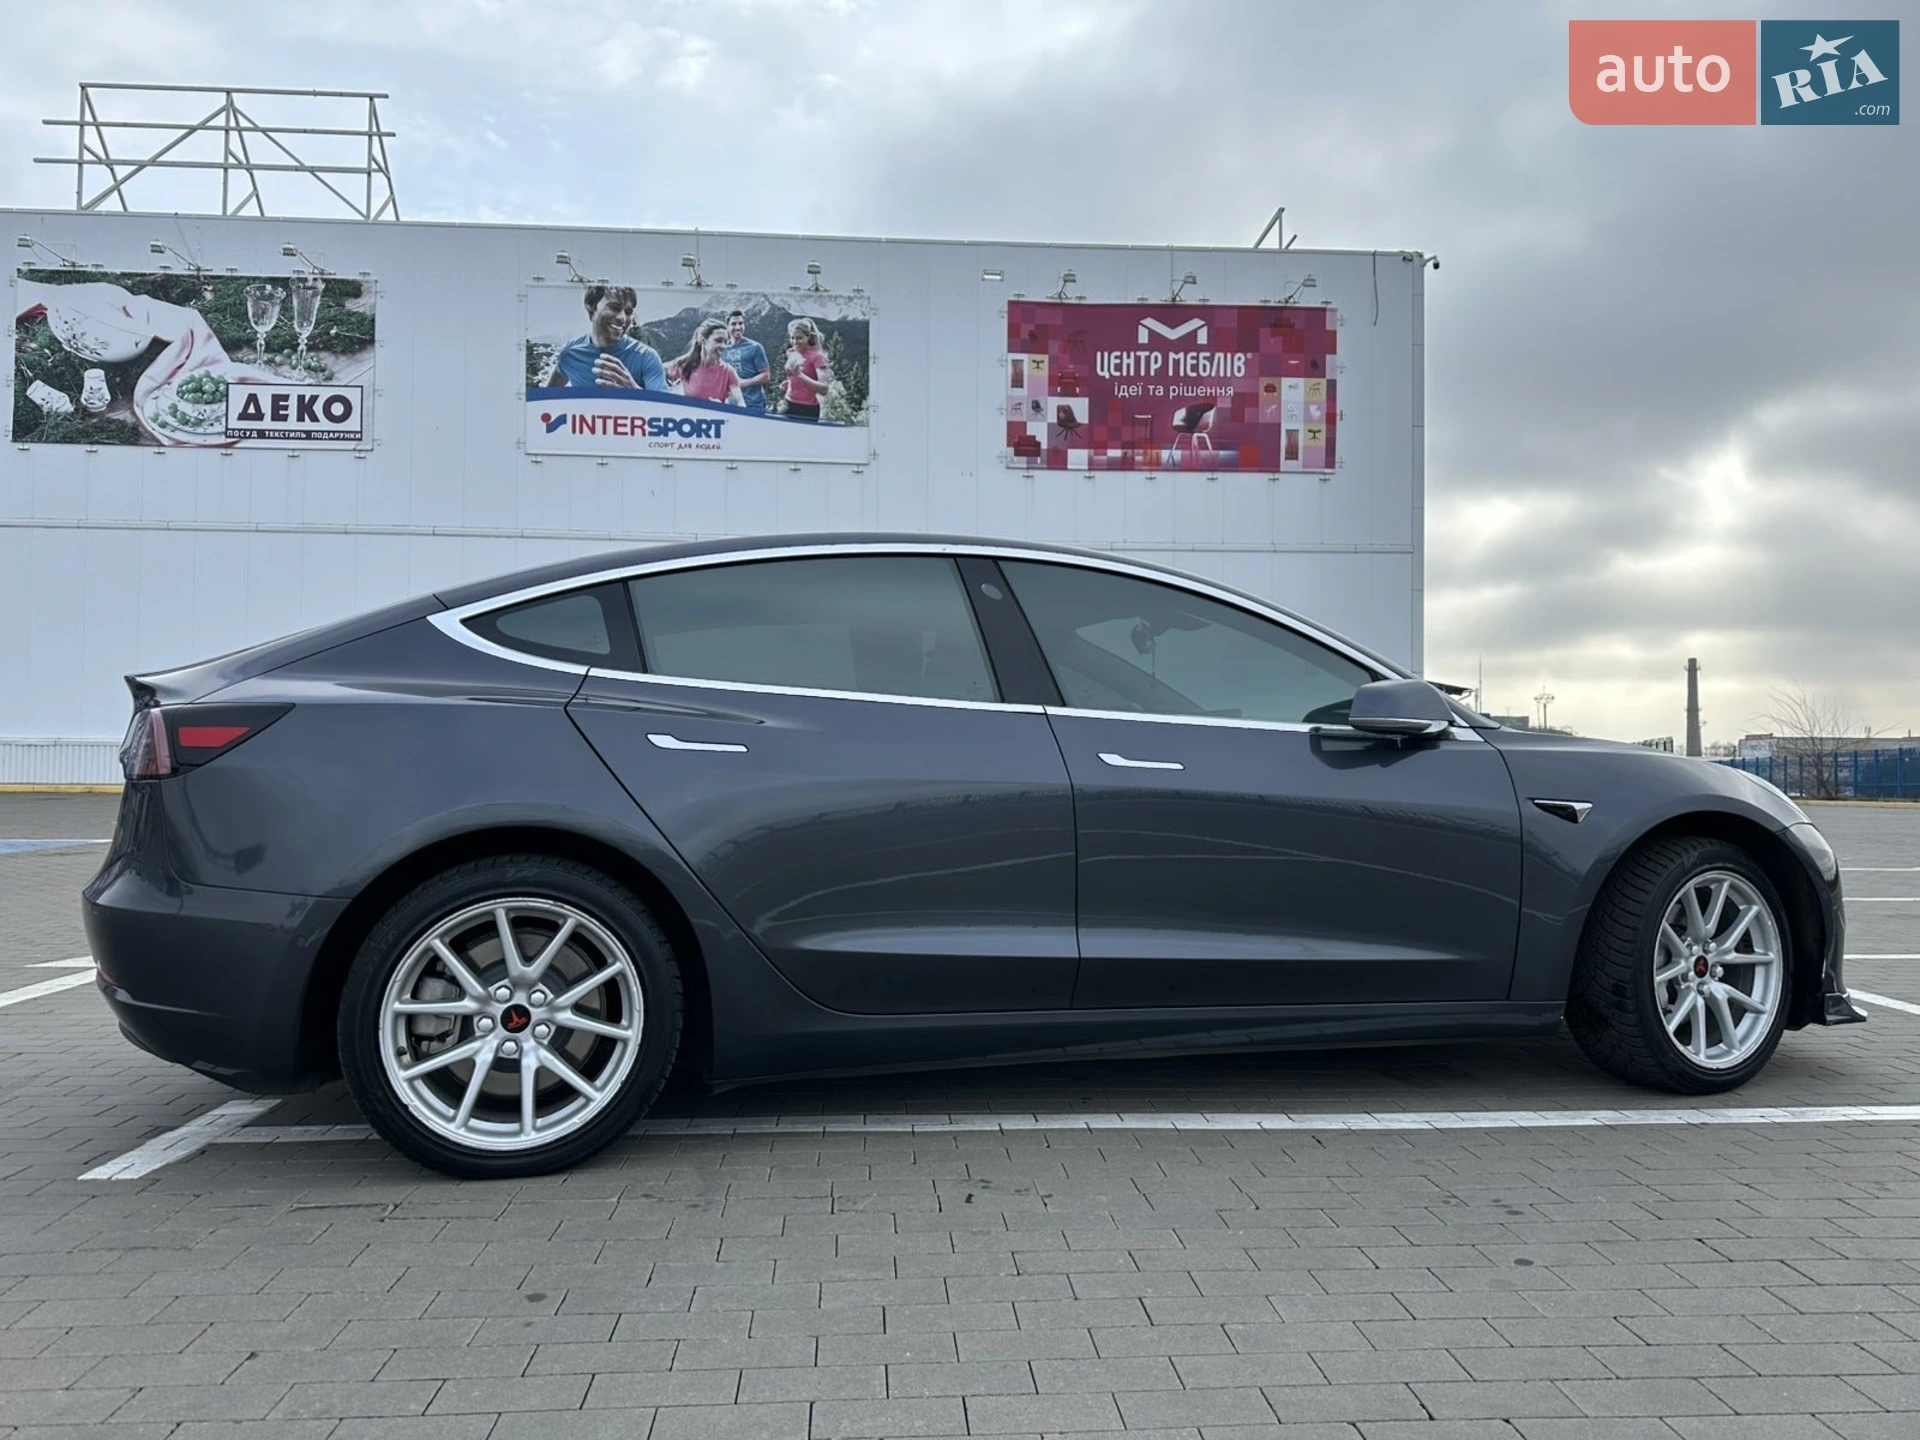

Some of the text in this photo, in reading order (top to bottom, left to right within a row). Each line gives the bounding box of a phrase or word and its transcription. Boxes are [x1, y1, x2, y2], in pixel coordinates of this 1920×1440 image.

[1096, 351, 1246, 379] ЦЕНТР МЕБЛІВ
[1114, 382, 1234, 399] ідеї та рішення
[236, 393, 353, 424] ДЕКО
[227, 430, 361, 440] ПОСУД ТЕКСТИЛЬ ПОДАРУНКИ
[571, 413, 726, 439] INTERSPORT
